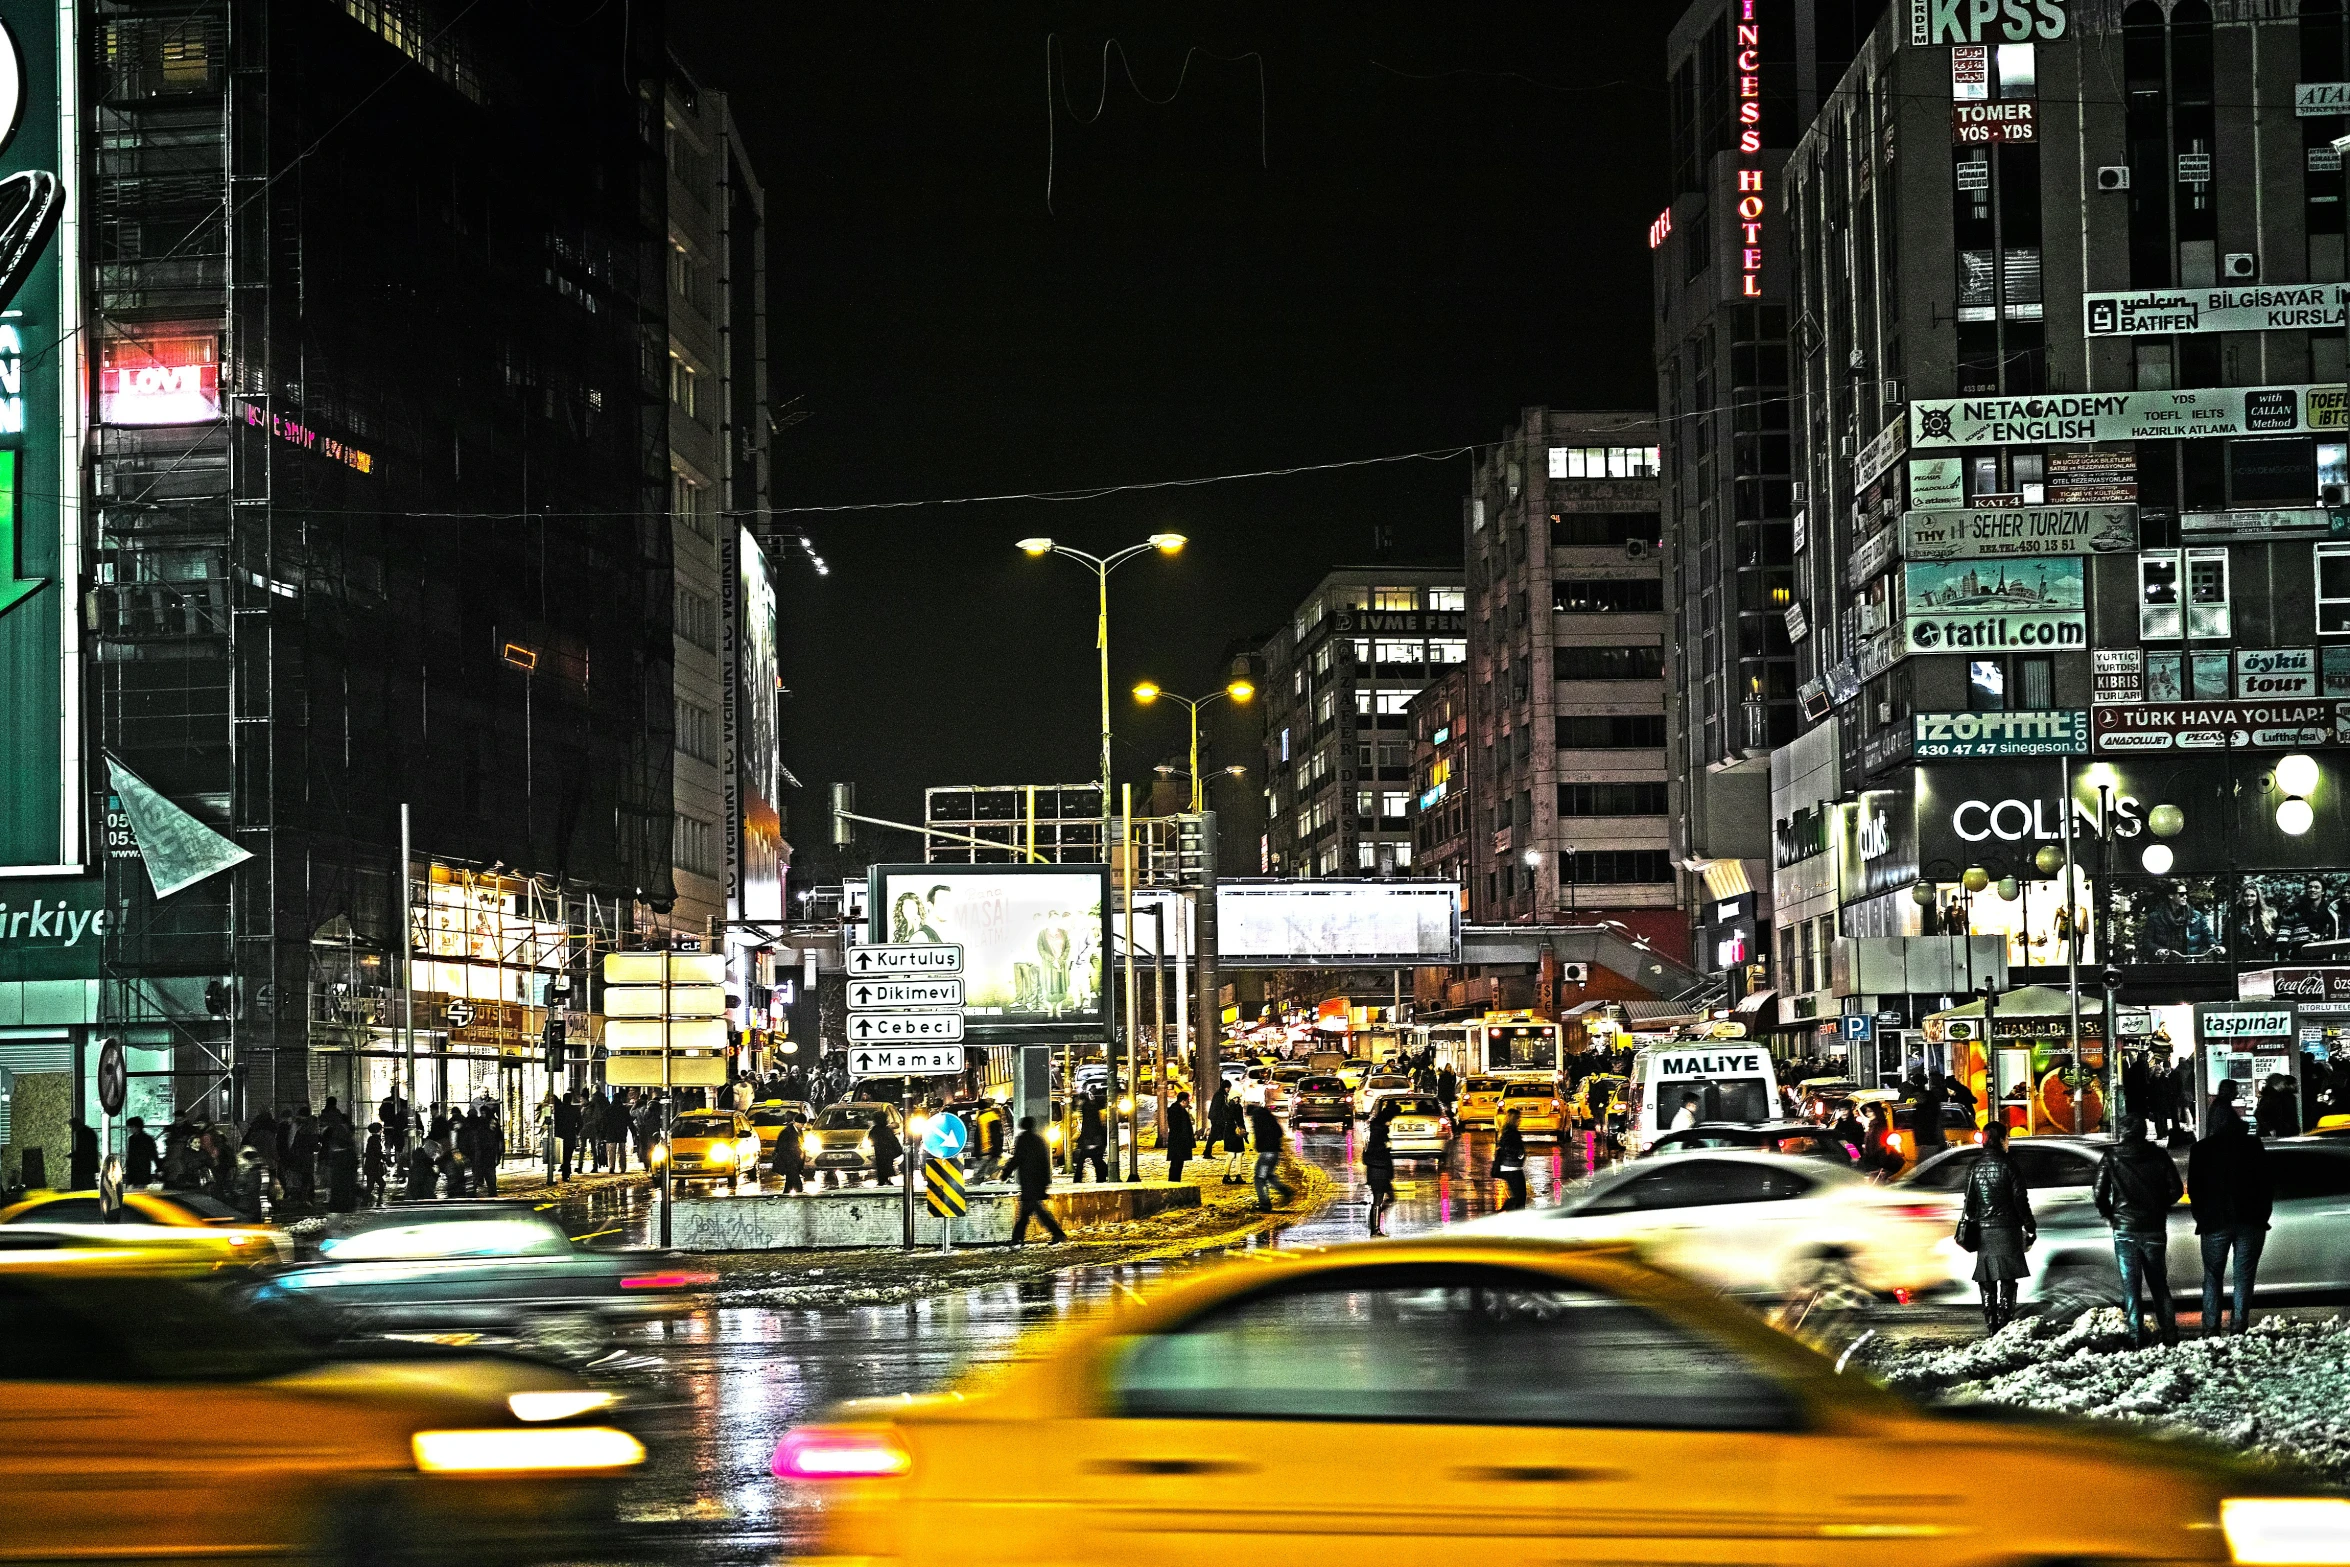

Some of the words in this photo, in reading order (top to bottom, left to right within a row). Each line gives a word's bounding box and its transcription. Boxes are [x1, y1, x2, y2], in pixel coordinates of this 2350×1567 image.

[1914, 0, 1927, 44] RDEM
[1931, 0, 2066, 44] KPSS
[1958, 103, 2032, 122] TÖMER
[1959, 124, 1989, 141] YÖS
[2002, 124, 2032, 139] YDS
[1738, 170, 1763, 297] HOTEL
[2208, 291, 2324, 309] BİLGİSAYAR
[2121, 314, 2199, 332] BATIFEN
[1963, 396, 2130, 421] NETACADEMY
[2172, 395, 2196, 404] YDS
[2144, 411, 2182, 421] TOEFL
[2192, 409, 2225, 419] IELTS
[2251, 406, 2292, 416] CALLAN
[1964, 424, 1991, 442] SCHOOLS
[1993, 419, 2096, 441] ENGLISH
[2132, 426, 2186, 437] HAZIRLIK
[2188, 424, 2238, 435] ATLAMA
[2252, 418, 2291, 429] Method
[1973, 513, 2023, 538] SEHER
[2029, 509, 2089, 536] TURİZM
[1915, 530, 1945, 541] THY
[2044, 540, 2058, 551] 13
[2061, 539, 2075, 550] 51
[1360, 612, 1417, 630] İVME
[1425, 615, 1466, 630] FEN
[1944, 618, 2084, 648] tatil.com
[2096, 650, 2139, 661] YURTİÇİ
[2244, 653, 2307, 672] öykü
[2096, 663, 2139, 672] YURTDIŞI
[2097, 675, 2139, 689] KIBRIS
[2246, 676, 2307, 693] tour
[2096, 691, 2140, 700] TURLARI
[2124, 708, 2176, 726] TÜRK
[2182, 709, 2238, 725] HAVA
[2104, 736, 2168, 746] ANADOLUJET
[2185, 732, 2239, 741] PEGASS
[1917, 745, 1949, 756] 430
[1952, 744, 1972, 755] 47
[1977, 743, 1996, 754] 47
[1953, 792, 2142, 841] COLIN'S
[878, 952, 955, 966] Kurtuluş
[878, 986, 955, 1000] Dikimevi
[2275, 976, 2324, 995] Coca-Cola
[878, 1020, 950, 1034] Cebeci
[1848, 1017, 1864, 1039] P
[2205, 1015, 2288, 1034] taşpınar
[878, 1052, 955, 1066] Mamak
